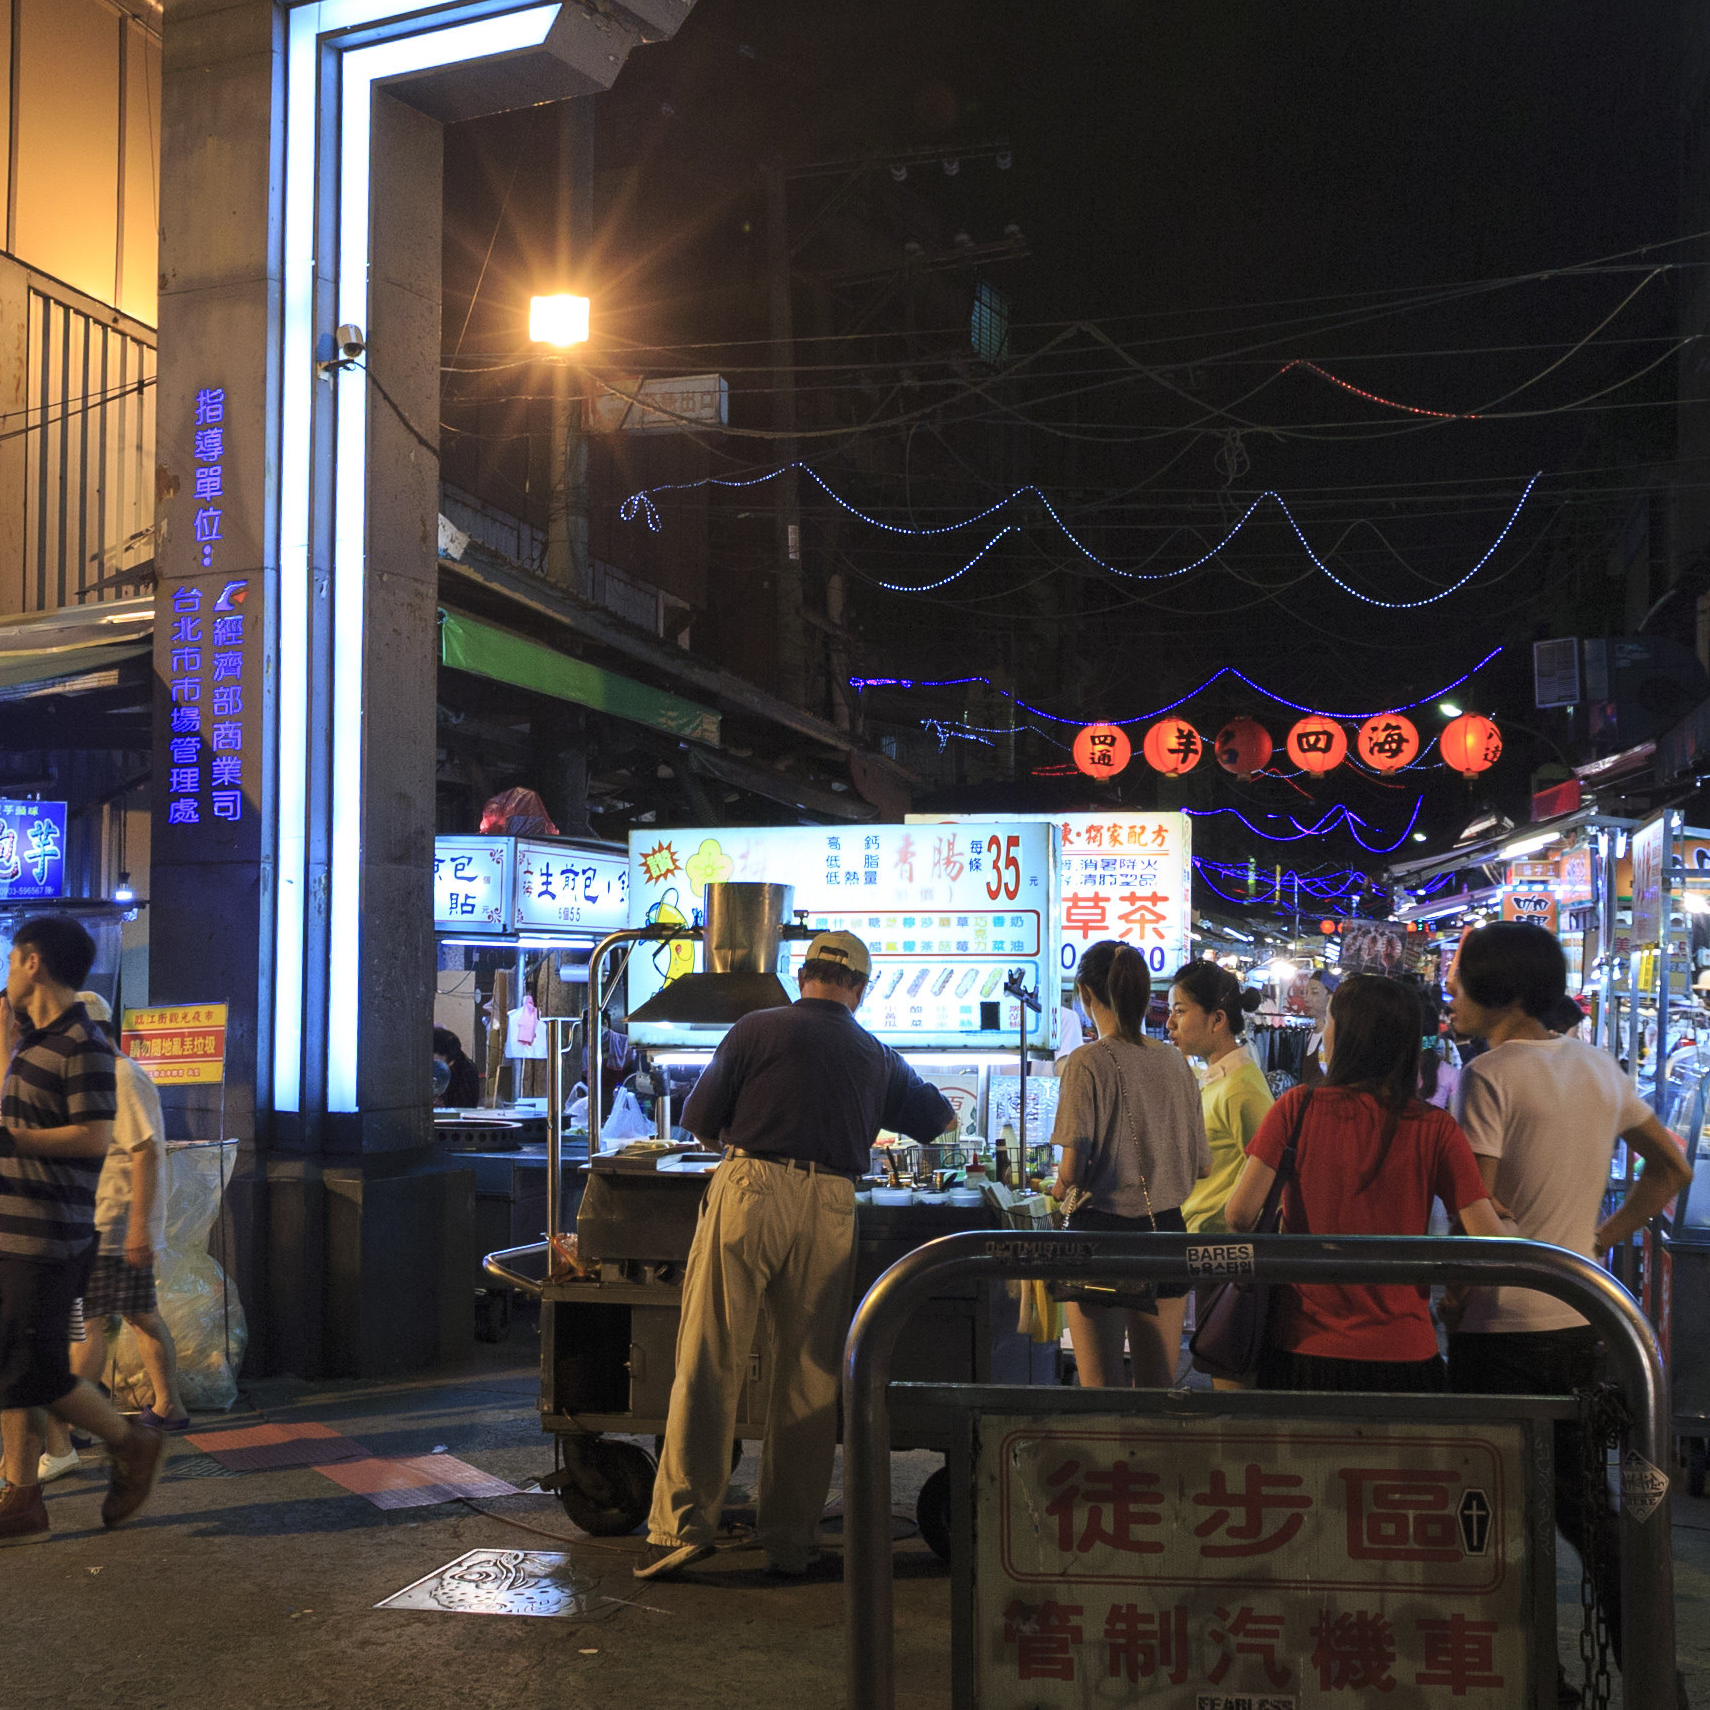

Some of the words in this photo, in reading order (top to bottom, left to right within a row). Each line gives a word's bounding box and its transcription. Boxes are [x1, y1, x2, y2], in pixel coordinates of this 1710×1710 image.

[194, 388, 225, 567] 指導單位：
[168, 586, 203, 824] 台北市市場管理處
[212, 614, 245, 821] 經濟部商業司
[1296, 729, 1334, 754] 四
[1368, 722, 1410, 758] 海
[826, 871, 878, 885] 低熱量
[969, 840, 983, 872] 每條
[986, 835, 1021, 901] 35
[129, 1036, 216, 1058] 請勿隨地亂丟垃圾
[1188, 1246, 1250, 1262] BARES
[1047, 1461, 1466, 1563] 徒步區
[1003, 1600, 1505, 1696] 管制汽機車
